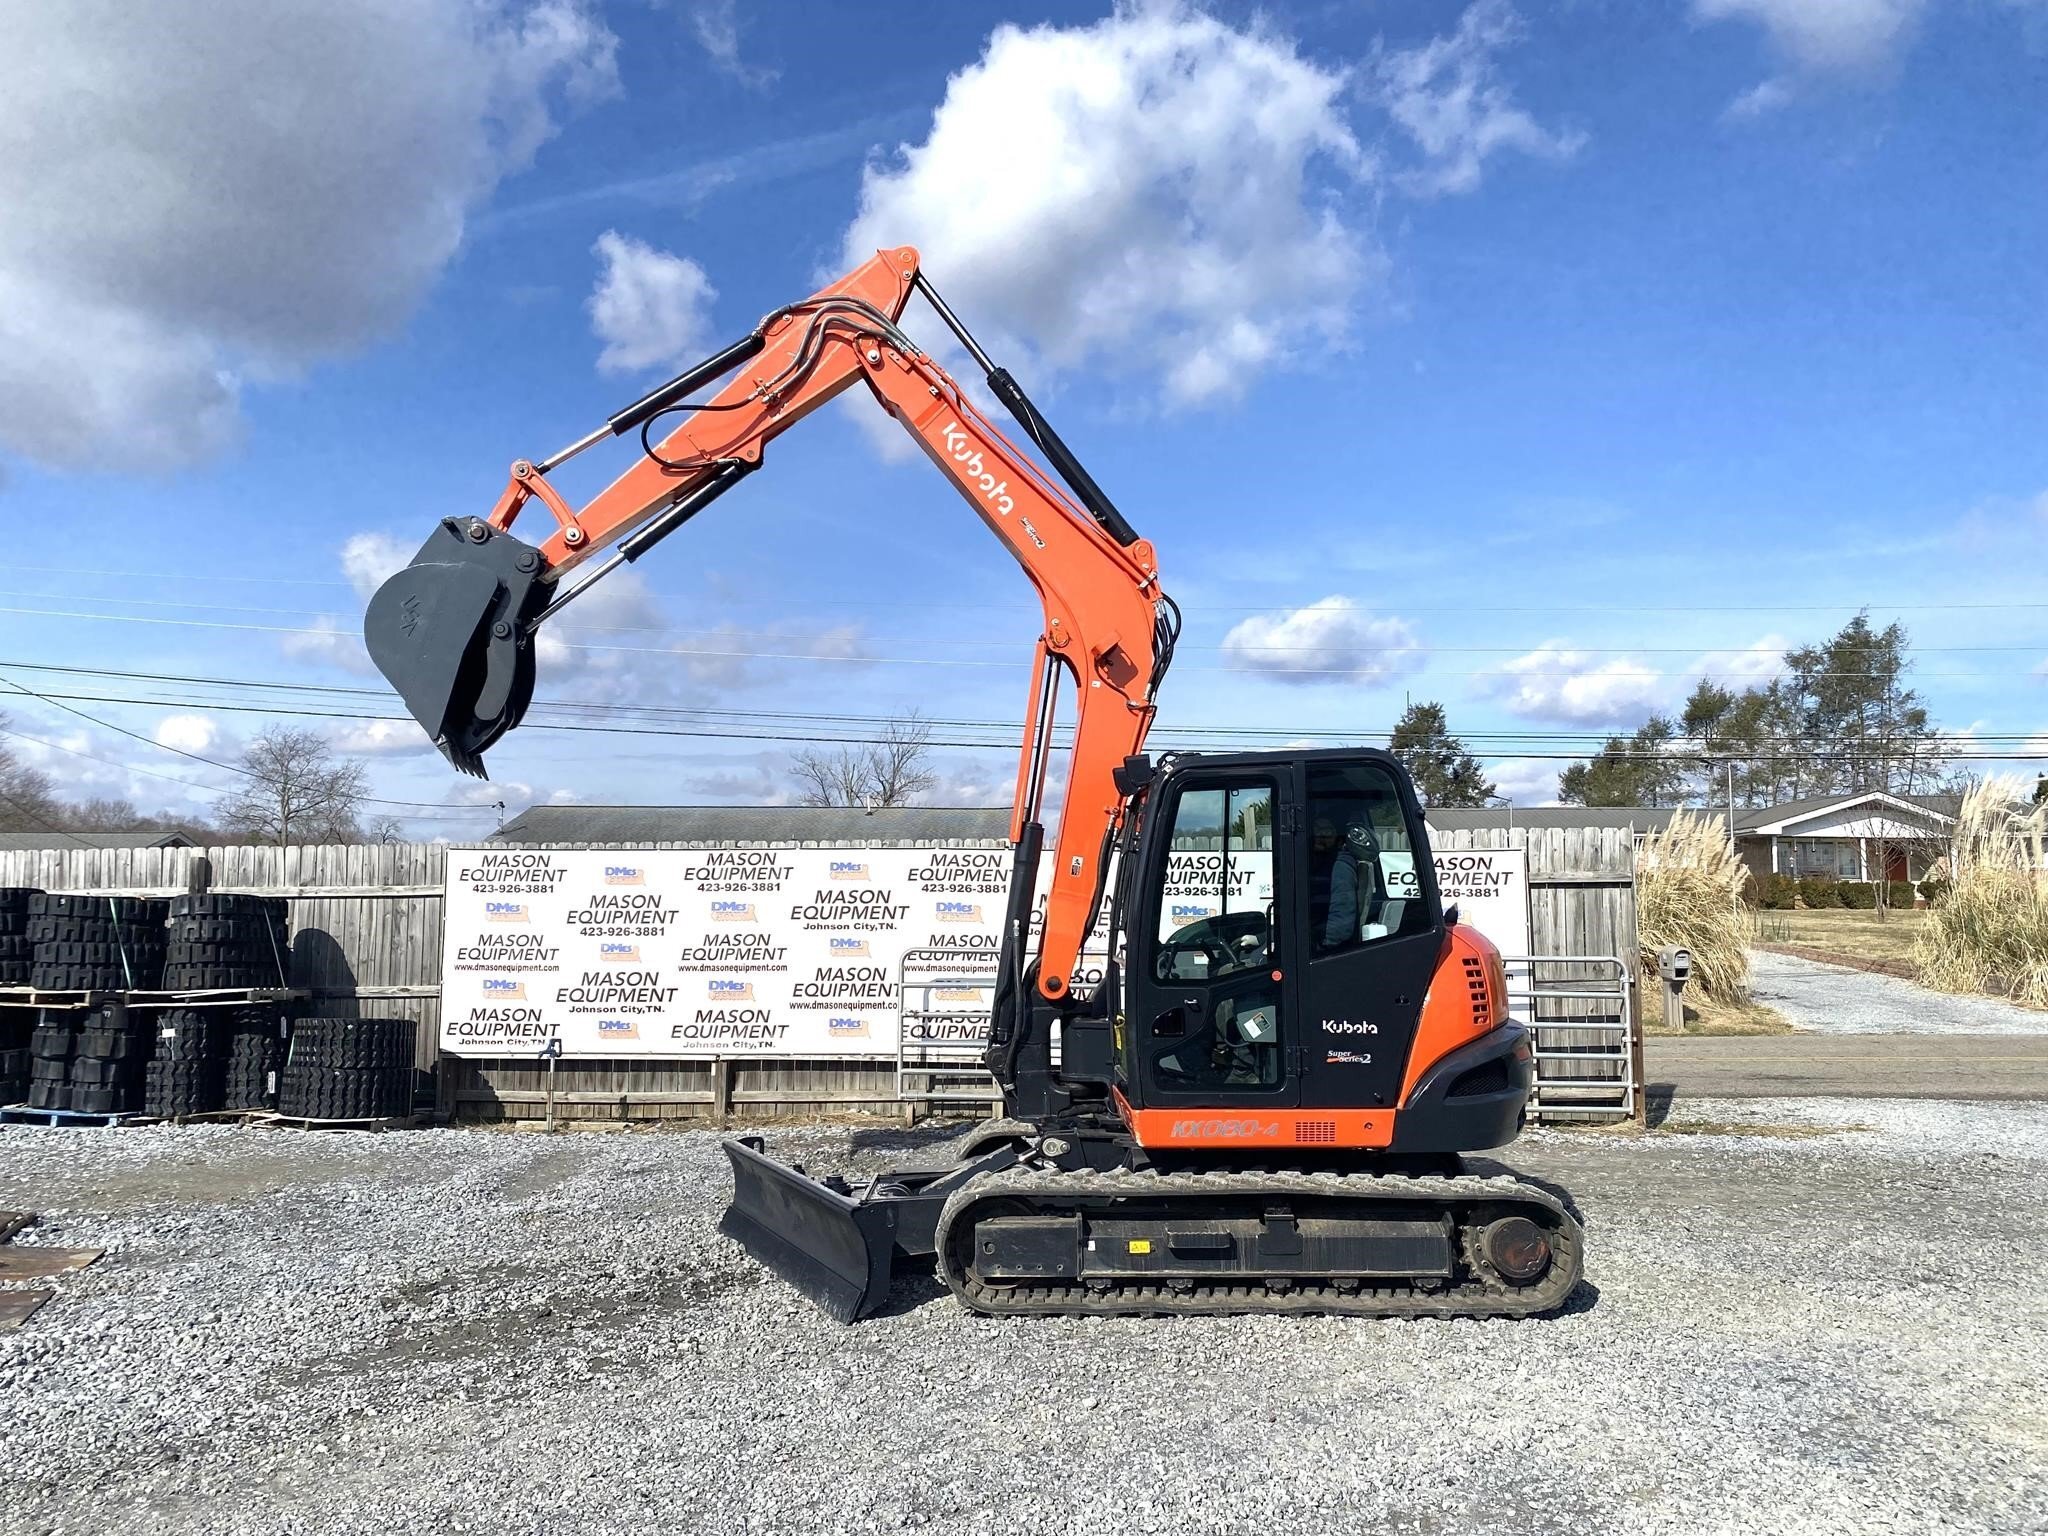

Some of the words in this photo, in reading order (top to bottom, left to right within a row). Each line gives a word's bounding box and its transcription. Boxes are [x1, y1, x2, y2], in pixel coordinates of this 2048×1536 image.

[942, 421, 1014, 515] Kubota
[481, 854, 551, 868] MASON
[706, 853, 776, 866] MASON
[930, 853, 1003, 868] MASON
[459, 868, 567, 883] EQUIPMENT
[683, 867, 794, 881] EQUIPMENT
[907, 868, 1015, 882] EQUIPMEN
[1164, 871, 1256, 885] UIPMENT
[472, 885, 554, 893] 423-926-3881
[697, 883, 781, 892] 423-926-3881
[921, 884, 1007, 893] 423-926-3881
[1163, 887, 1243, 897] 23-926-381
[589, 895, 662, 909] MASON
[814, 889, 892, 904] MASON
[566, 911, 679, 925] EQUIPMENT
[790, 905, 910, 921] EQUIPMENT
[579, 927, 665, 937] 423-926-3881
[802, 922, 850, 931] Johnson
[853, 922, 898, 932] City,TN.
[477, 934, 544, 947] MASON
[702, 934, 771, 947] MASON
[928, 934, 998, 948] MASON
[457, 948, 560, 961] EQUIPMENT
[681, 948, 788, 961] EQUIPMENT
[454, 963, 560, 973] www.dmasonequipment.com
[678, 964, 788, 973] www.dmasonequipment.com
[815, 967, 887, 982] MASON
[904, 963, 998, 975] www.dmasonequipment
[580, 972, 659, 986] MASON
[555, 988, 678, 1003] EQUIPMENT
[792, 983, 899, 998] EQUIPMENT
[568, 1005, 617, 1014] Johnson
[619, 1005, 665, 1015] City,TN.
[789, 1000, 898, 1012] www.dmasonequipment.co
[469, 1008, 543, 1022] MASON
[694, 1009, 771, 1024] MASON
[446, 1022, 560, 1037] EQUIPMENT
[670, 1024, 790, 1039] EQUIPMENT
[903, 1025, 988, 1039] EQUIPME
[1322, 1020, 1378, 1034] Kubota
[458, 1038, 504, 1046] Johnson
[682, 1041, 729, 1049] Johnson
[1327, 1050, 1352, 1058] Super
